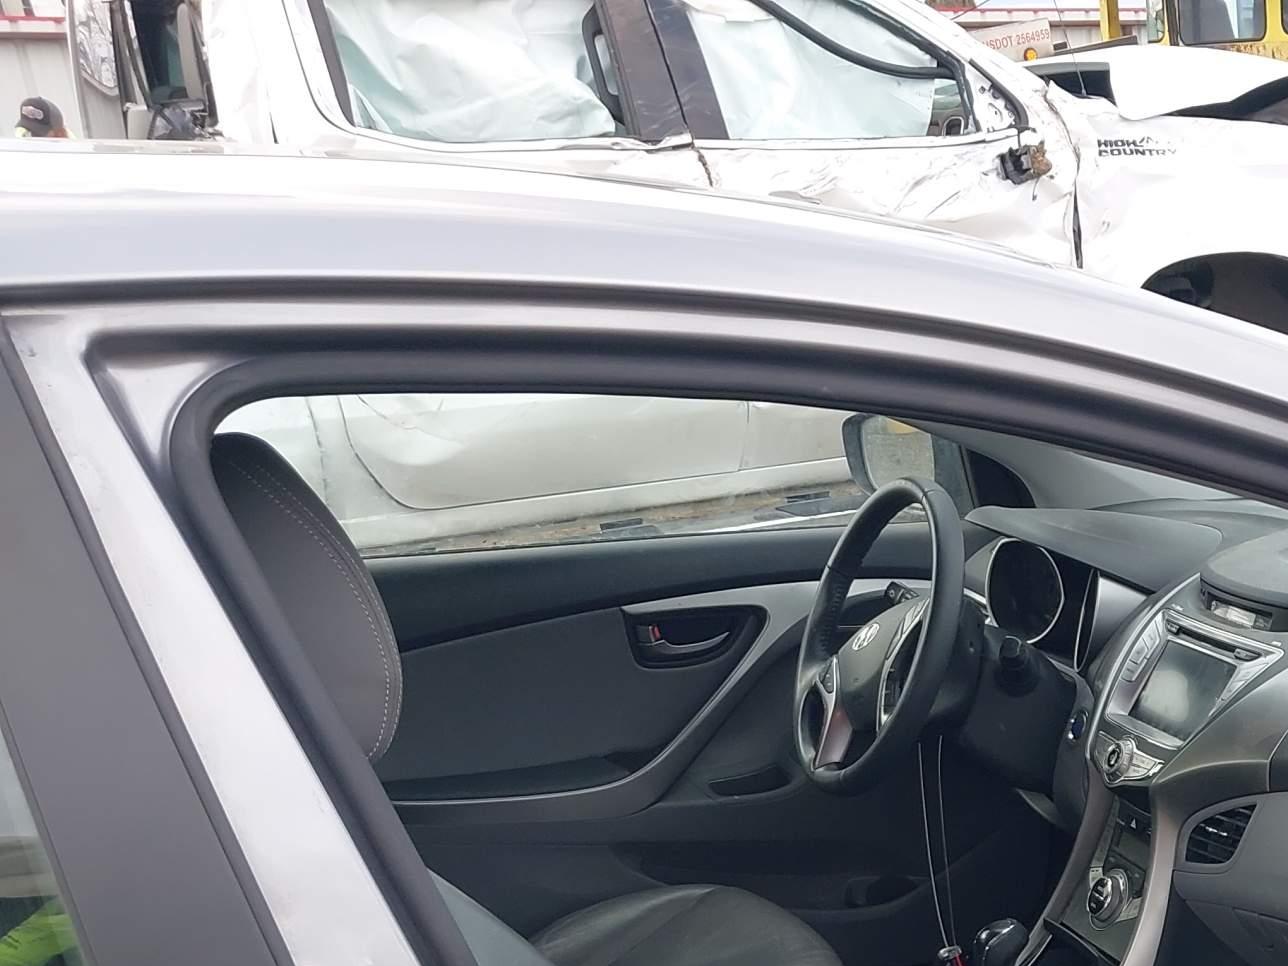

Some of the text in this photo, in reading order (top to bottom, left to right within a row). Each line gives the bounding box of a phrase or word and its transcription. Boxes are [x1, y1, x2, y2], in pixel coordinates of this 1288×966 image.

[1015, 28, 1050, 46] 2564959
[1097, 138, 1141, 148] HIGH
[1098, 148, 1177, 157] COUNTRY
